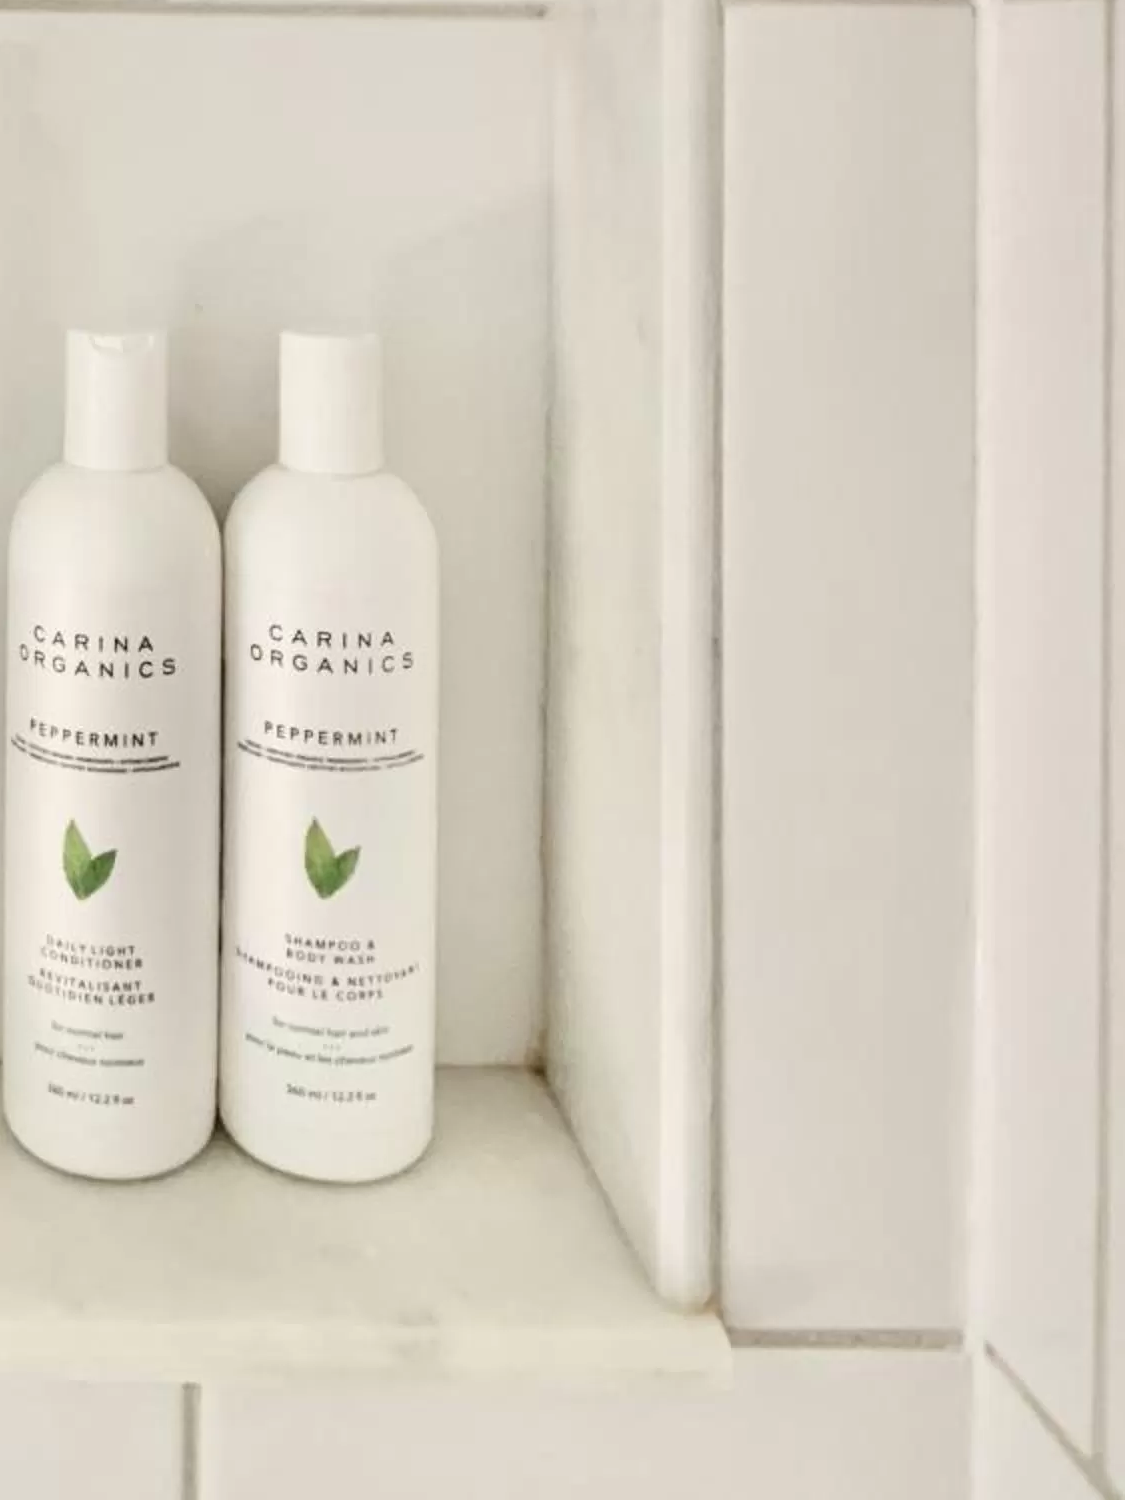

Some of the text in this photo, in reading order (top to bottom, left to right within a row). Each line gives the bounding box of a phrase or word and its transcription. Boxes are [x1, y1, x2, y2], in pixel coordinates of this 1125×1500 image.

[33, 625, 154, 653] CARINA
[268, 624, 395, 649] CARINA
[19, 643, 176, 680] ORGANICS
[250, 643, 414, 675] ORGANICS
[30, 717, 159, 748] PEPPERMINT
[264, 719, 398, 746] PEPPERMINT
[91, 945, 136, 958] LIGHT
[284, 933, 361, 951] SHAMPOO
[40, 946, 144, 970] CONDITIONER
[286, 948, 376, 965] BODY WASH
[39, 967, 142, 993] REVITALISANT
[268, 977, 384, 1001] POUR LE CORPS
